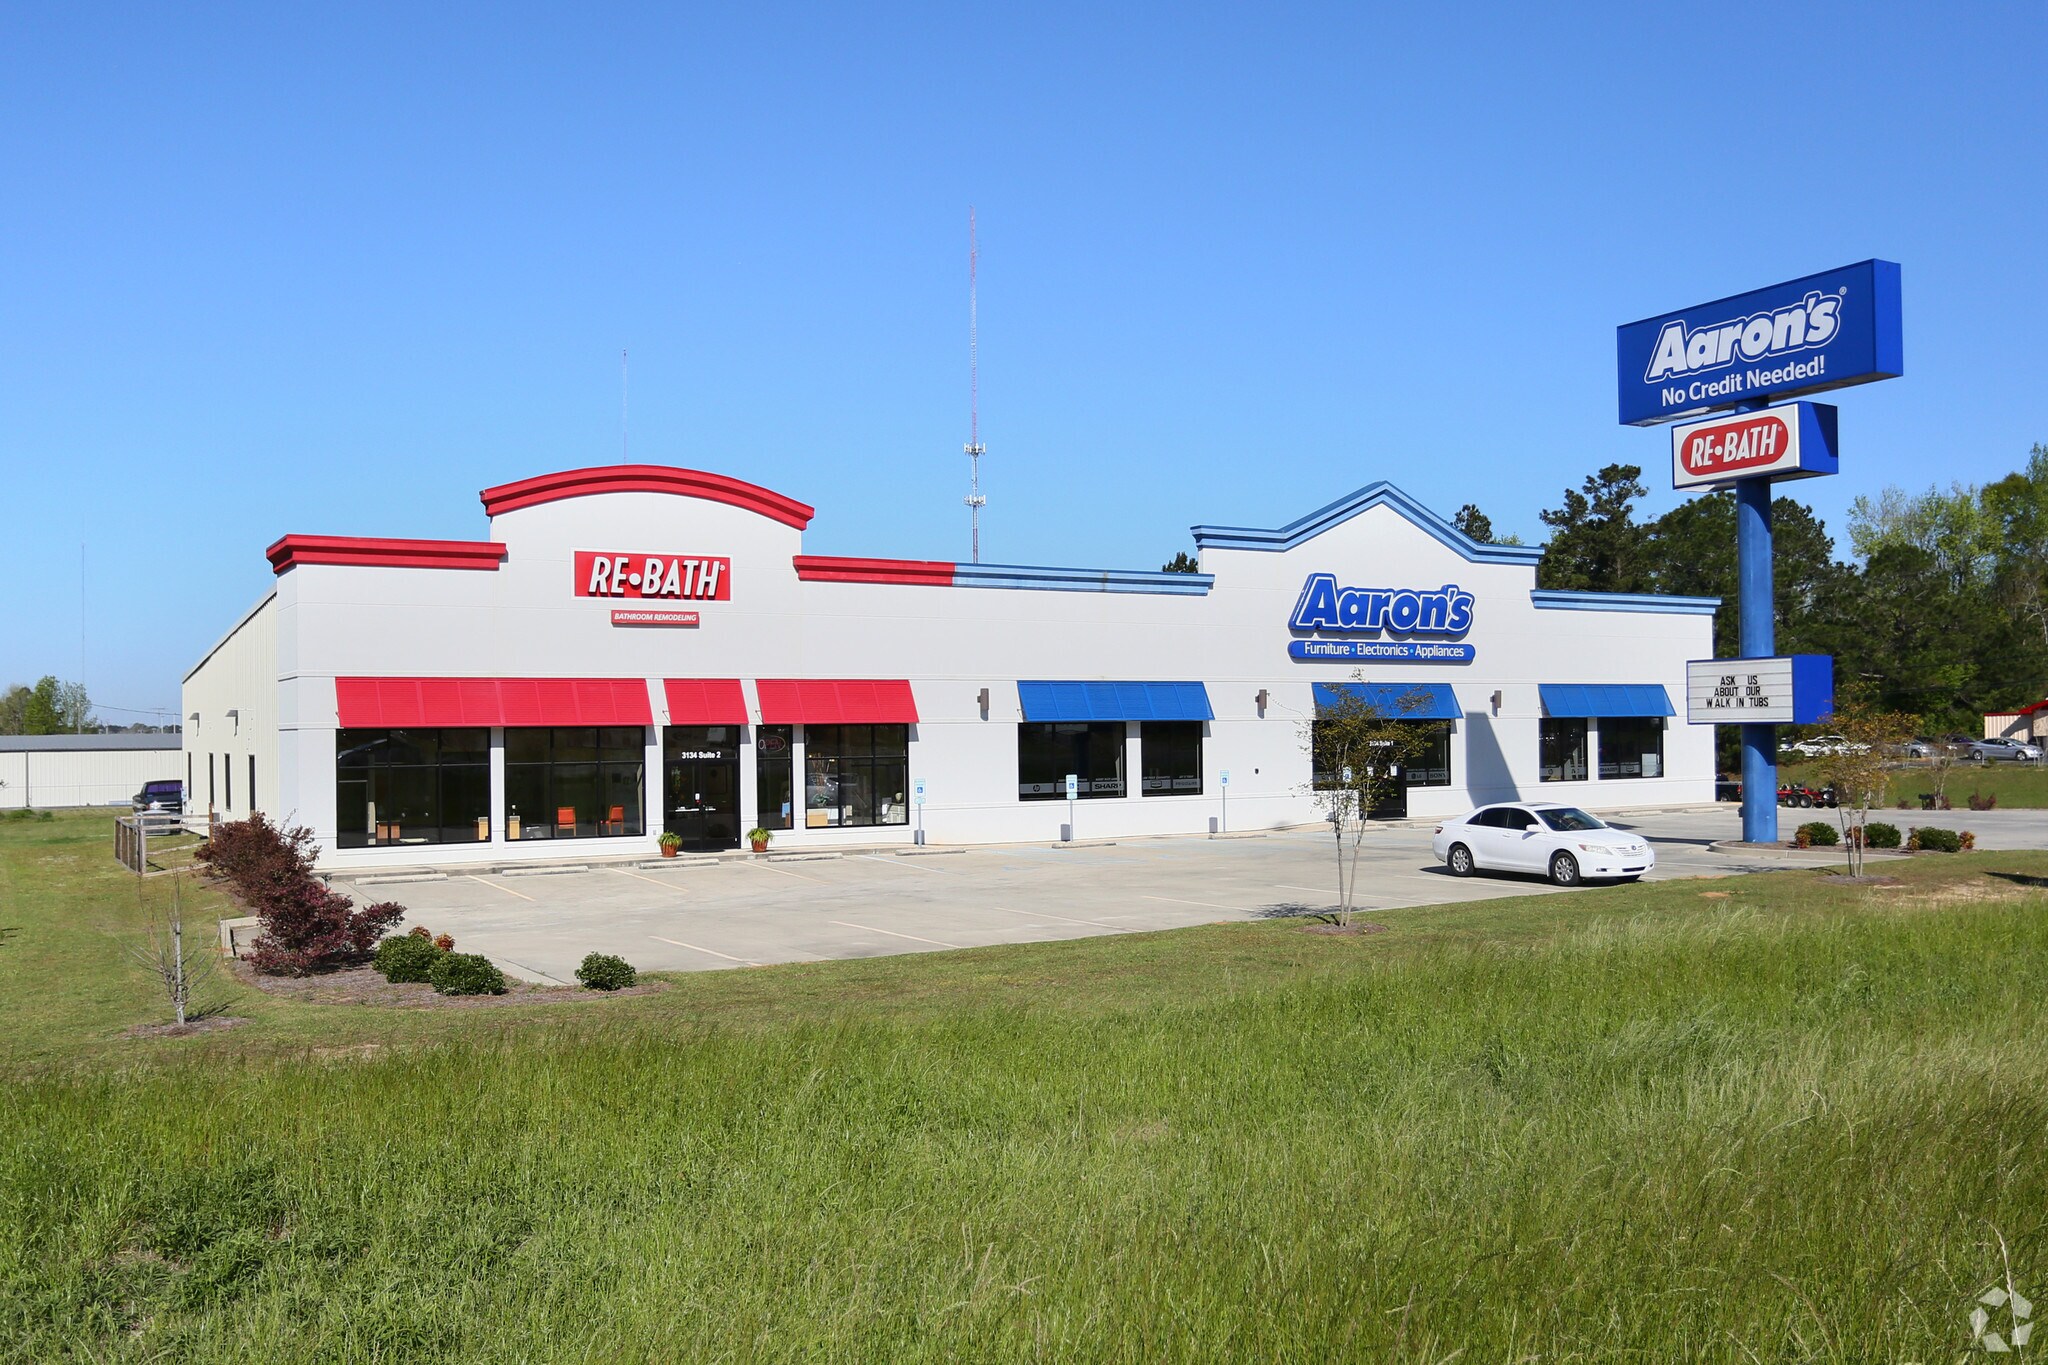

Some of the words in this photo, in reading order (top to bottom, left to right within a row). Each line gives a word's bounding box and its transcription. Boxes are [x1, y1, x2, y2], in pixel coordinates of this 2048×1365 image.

[1645, 292, 1841, 382] Aaron's
[1661, 387, 1686, 407] No
[1688, 373, 1743, 402] Credit
[1746, 354, 1826, 390] Needed!
[1293, 574, 1474, 633] Aaron's
[613, 612, 654, 621] BATHROOM
[654, 613, 697, 622] REMODELING
[1304, 642, 1350, 655] Furniture
[1357, 643, 1408, 656] Electronics
[1415, 644, 1465, 659] Appliances
[1720, 675, 1736, 686] ASK
[1747, 675, 1758, 685] US
[1713, 686, 1739, 697] ABOUT
[1745, 686, 1761, 696] OUR
[1706, 697, 1731, 708] WALK
[1735, 697, 1745, 707] IN
[1749, 697, 1769, 707] TUBS
[681, 751, 698, 759] 3134
[698, 751, 716, 759] Suite
[716, 751, 721, 759] 2
